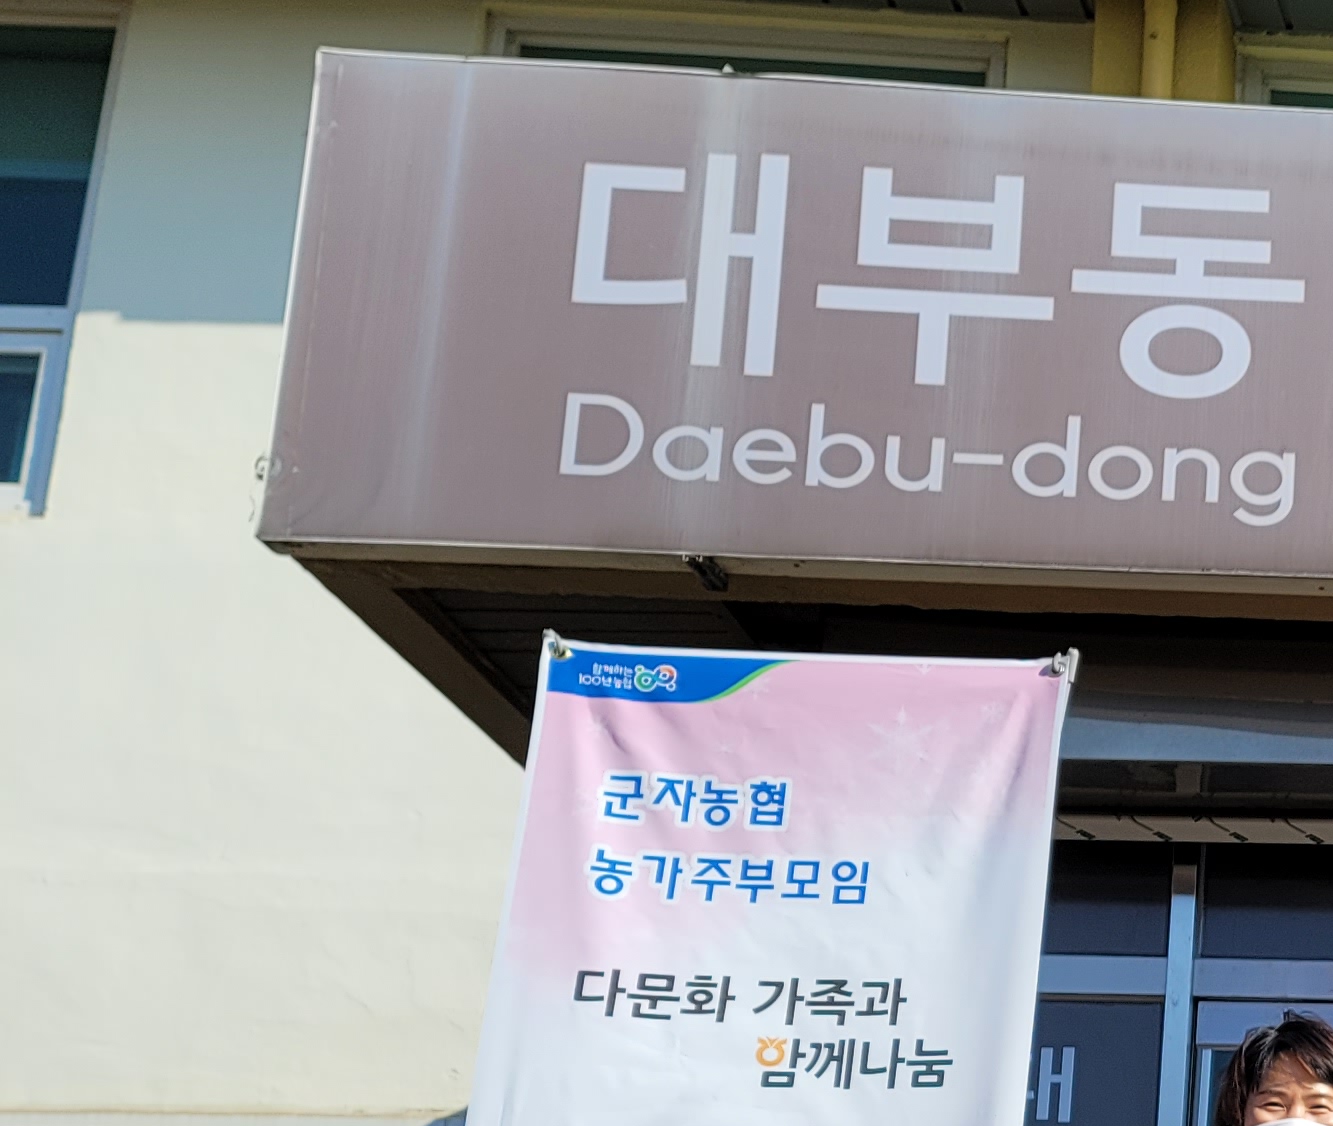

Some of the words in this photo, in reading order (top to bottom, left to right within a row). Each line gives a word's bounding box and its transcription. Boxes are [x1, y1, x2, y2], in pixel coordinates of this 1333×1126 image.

[571, 153, 1306, 399] 대부동
[559, 392, 1297, 526] Daebu-dong
[602, 774, 790, 827] 군자농협
[589, 849, 870, 905] 농가주부모임
[572, 968, 736, 1023] 다문화
[751, 976, 908, 1026] 가족과
